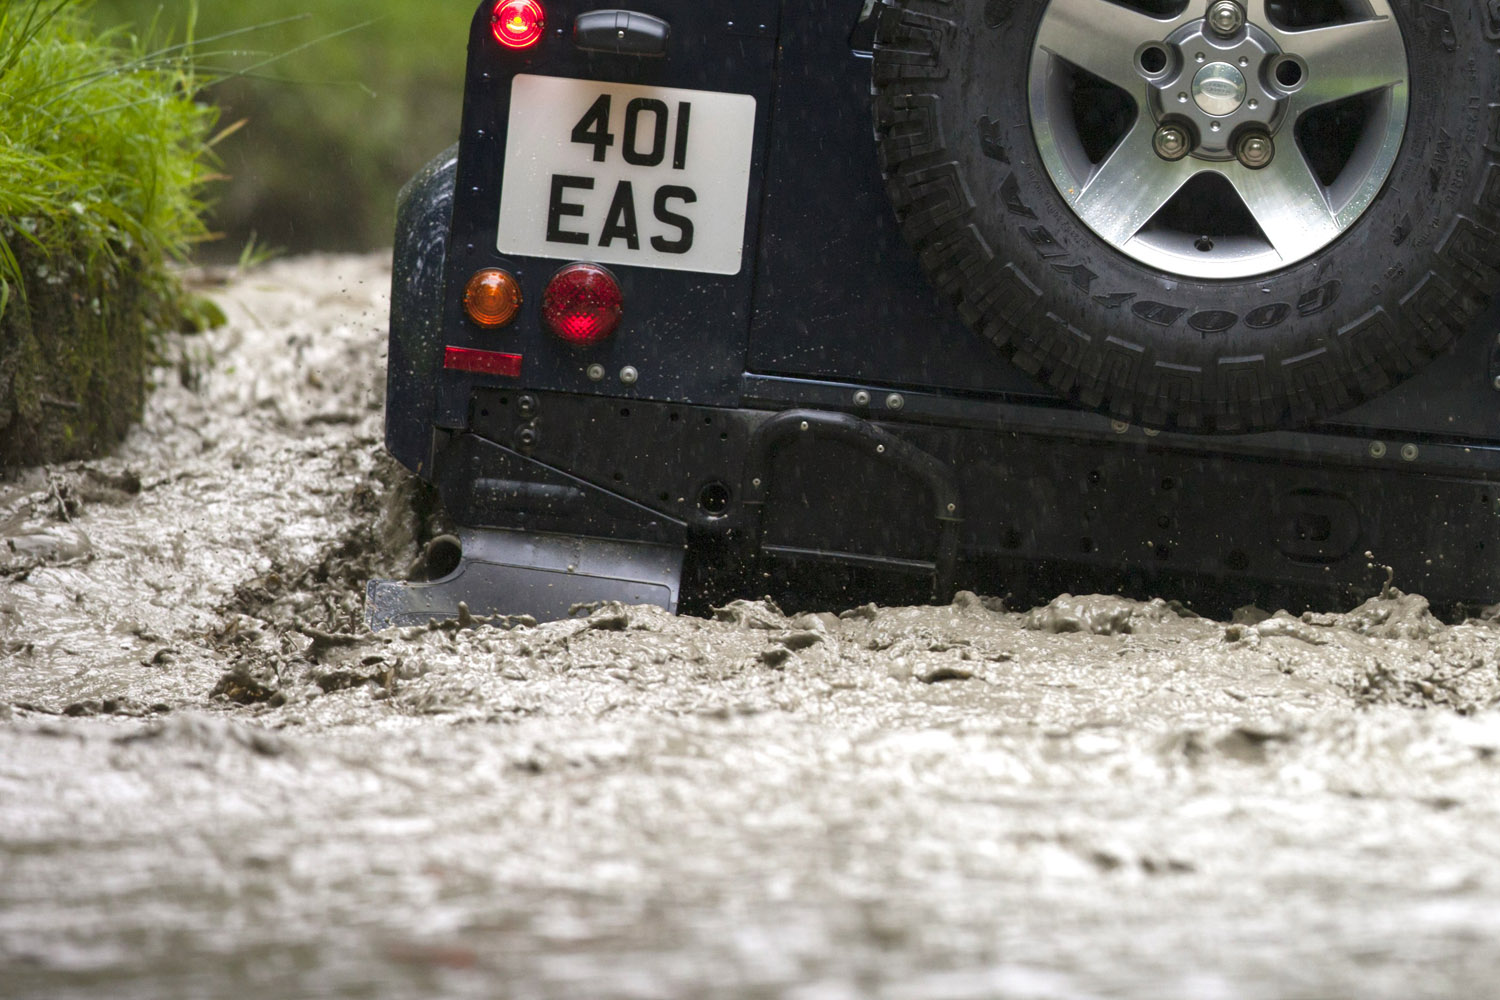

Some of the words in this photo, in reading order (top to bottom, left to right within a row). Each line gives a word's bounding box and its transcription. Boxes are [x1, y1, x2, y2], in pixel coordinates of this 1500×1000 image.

[570, 93, 691, 170] 401
[545, 173, 698, 254] EAS
[975, 113, 1343, 333] GOODYEAR
